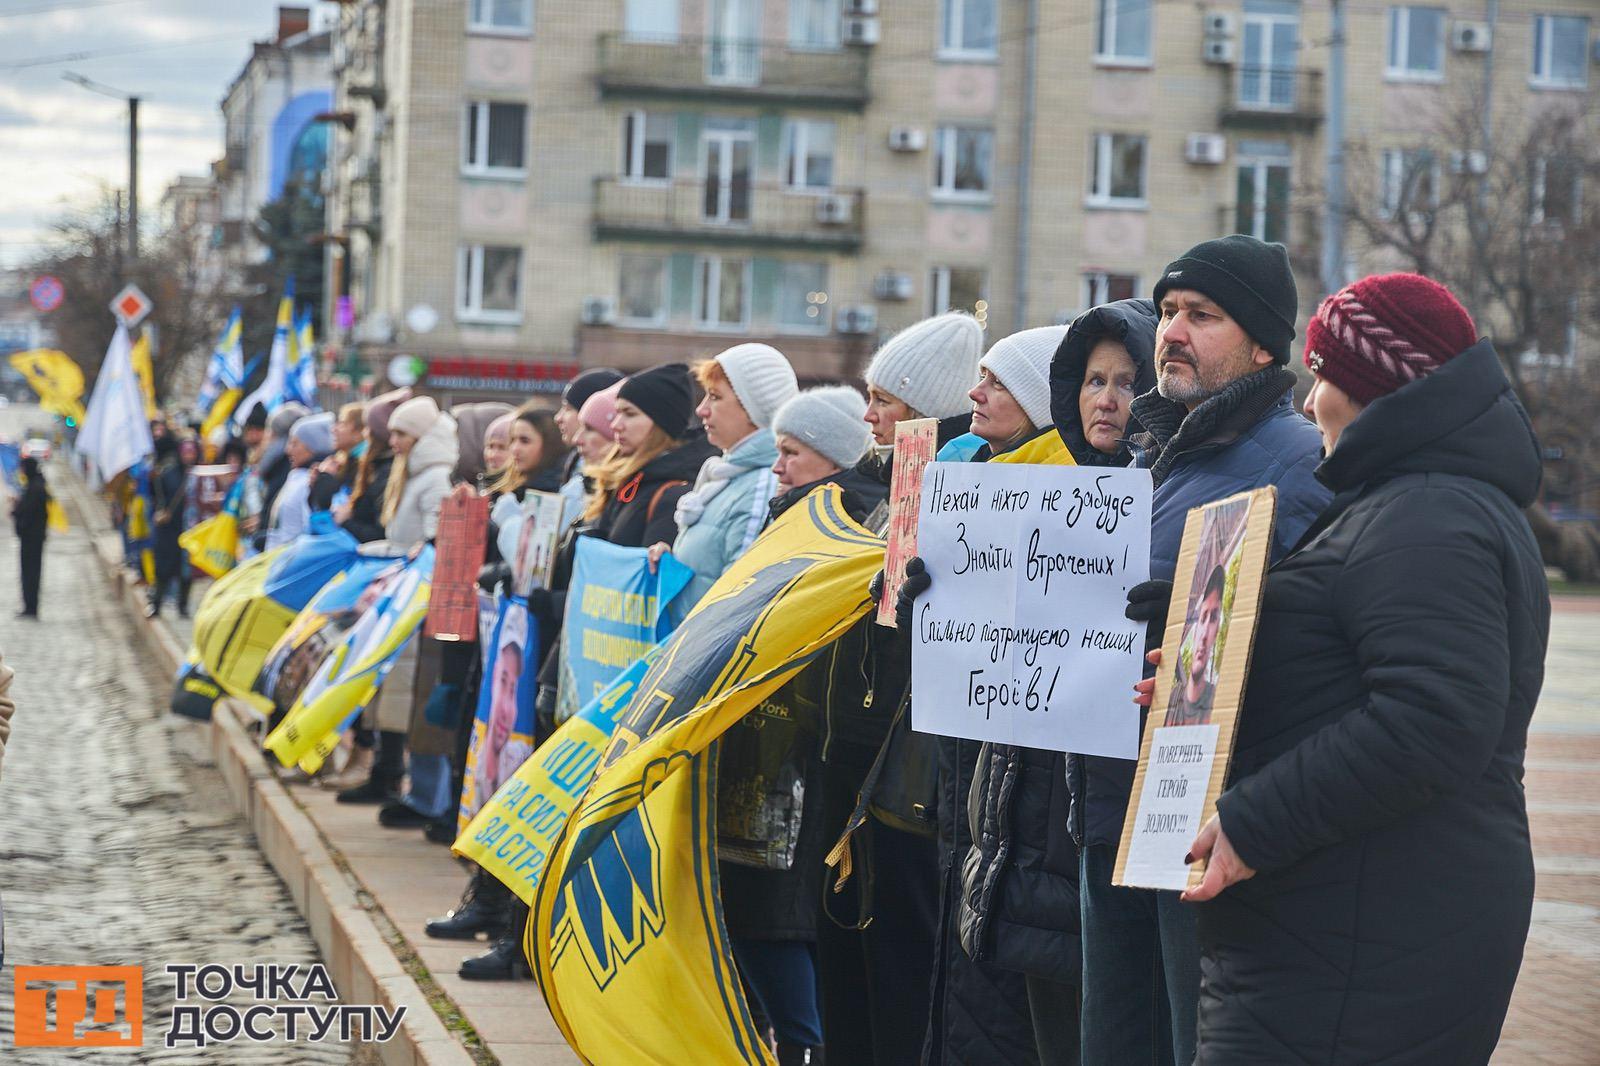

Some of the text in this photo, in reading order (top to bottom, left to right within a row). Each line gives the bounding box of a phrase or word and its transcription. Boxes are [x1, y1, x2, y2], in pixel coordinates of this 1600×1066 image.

[930, 469, 980, 515] Нехай
[991, 488, 1030, 512] ніхто
[1041, 489, 1062, 512] не
[1066, 475, 1134, 534] забуде
[953, 522, 1013, 575] Знайти
[921, 602, 1138, 667] Спільно підтримуємо наших
[968, 666, 1061, 720] Героїв!
[1156, 745, 1204, 764] ПОВЕРНІТЬ
[1156, 774, 1189, 799] ГЕРОЇВ
[475, 816, 510, 848] ЗА
[517, 793, 567, 844] СИЛ
[1142, 813, 1189, 834] ДОДОМУ!!!
